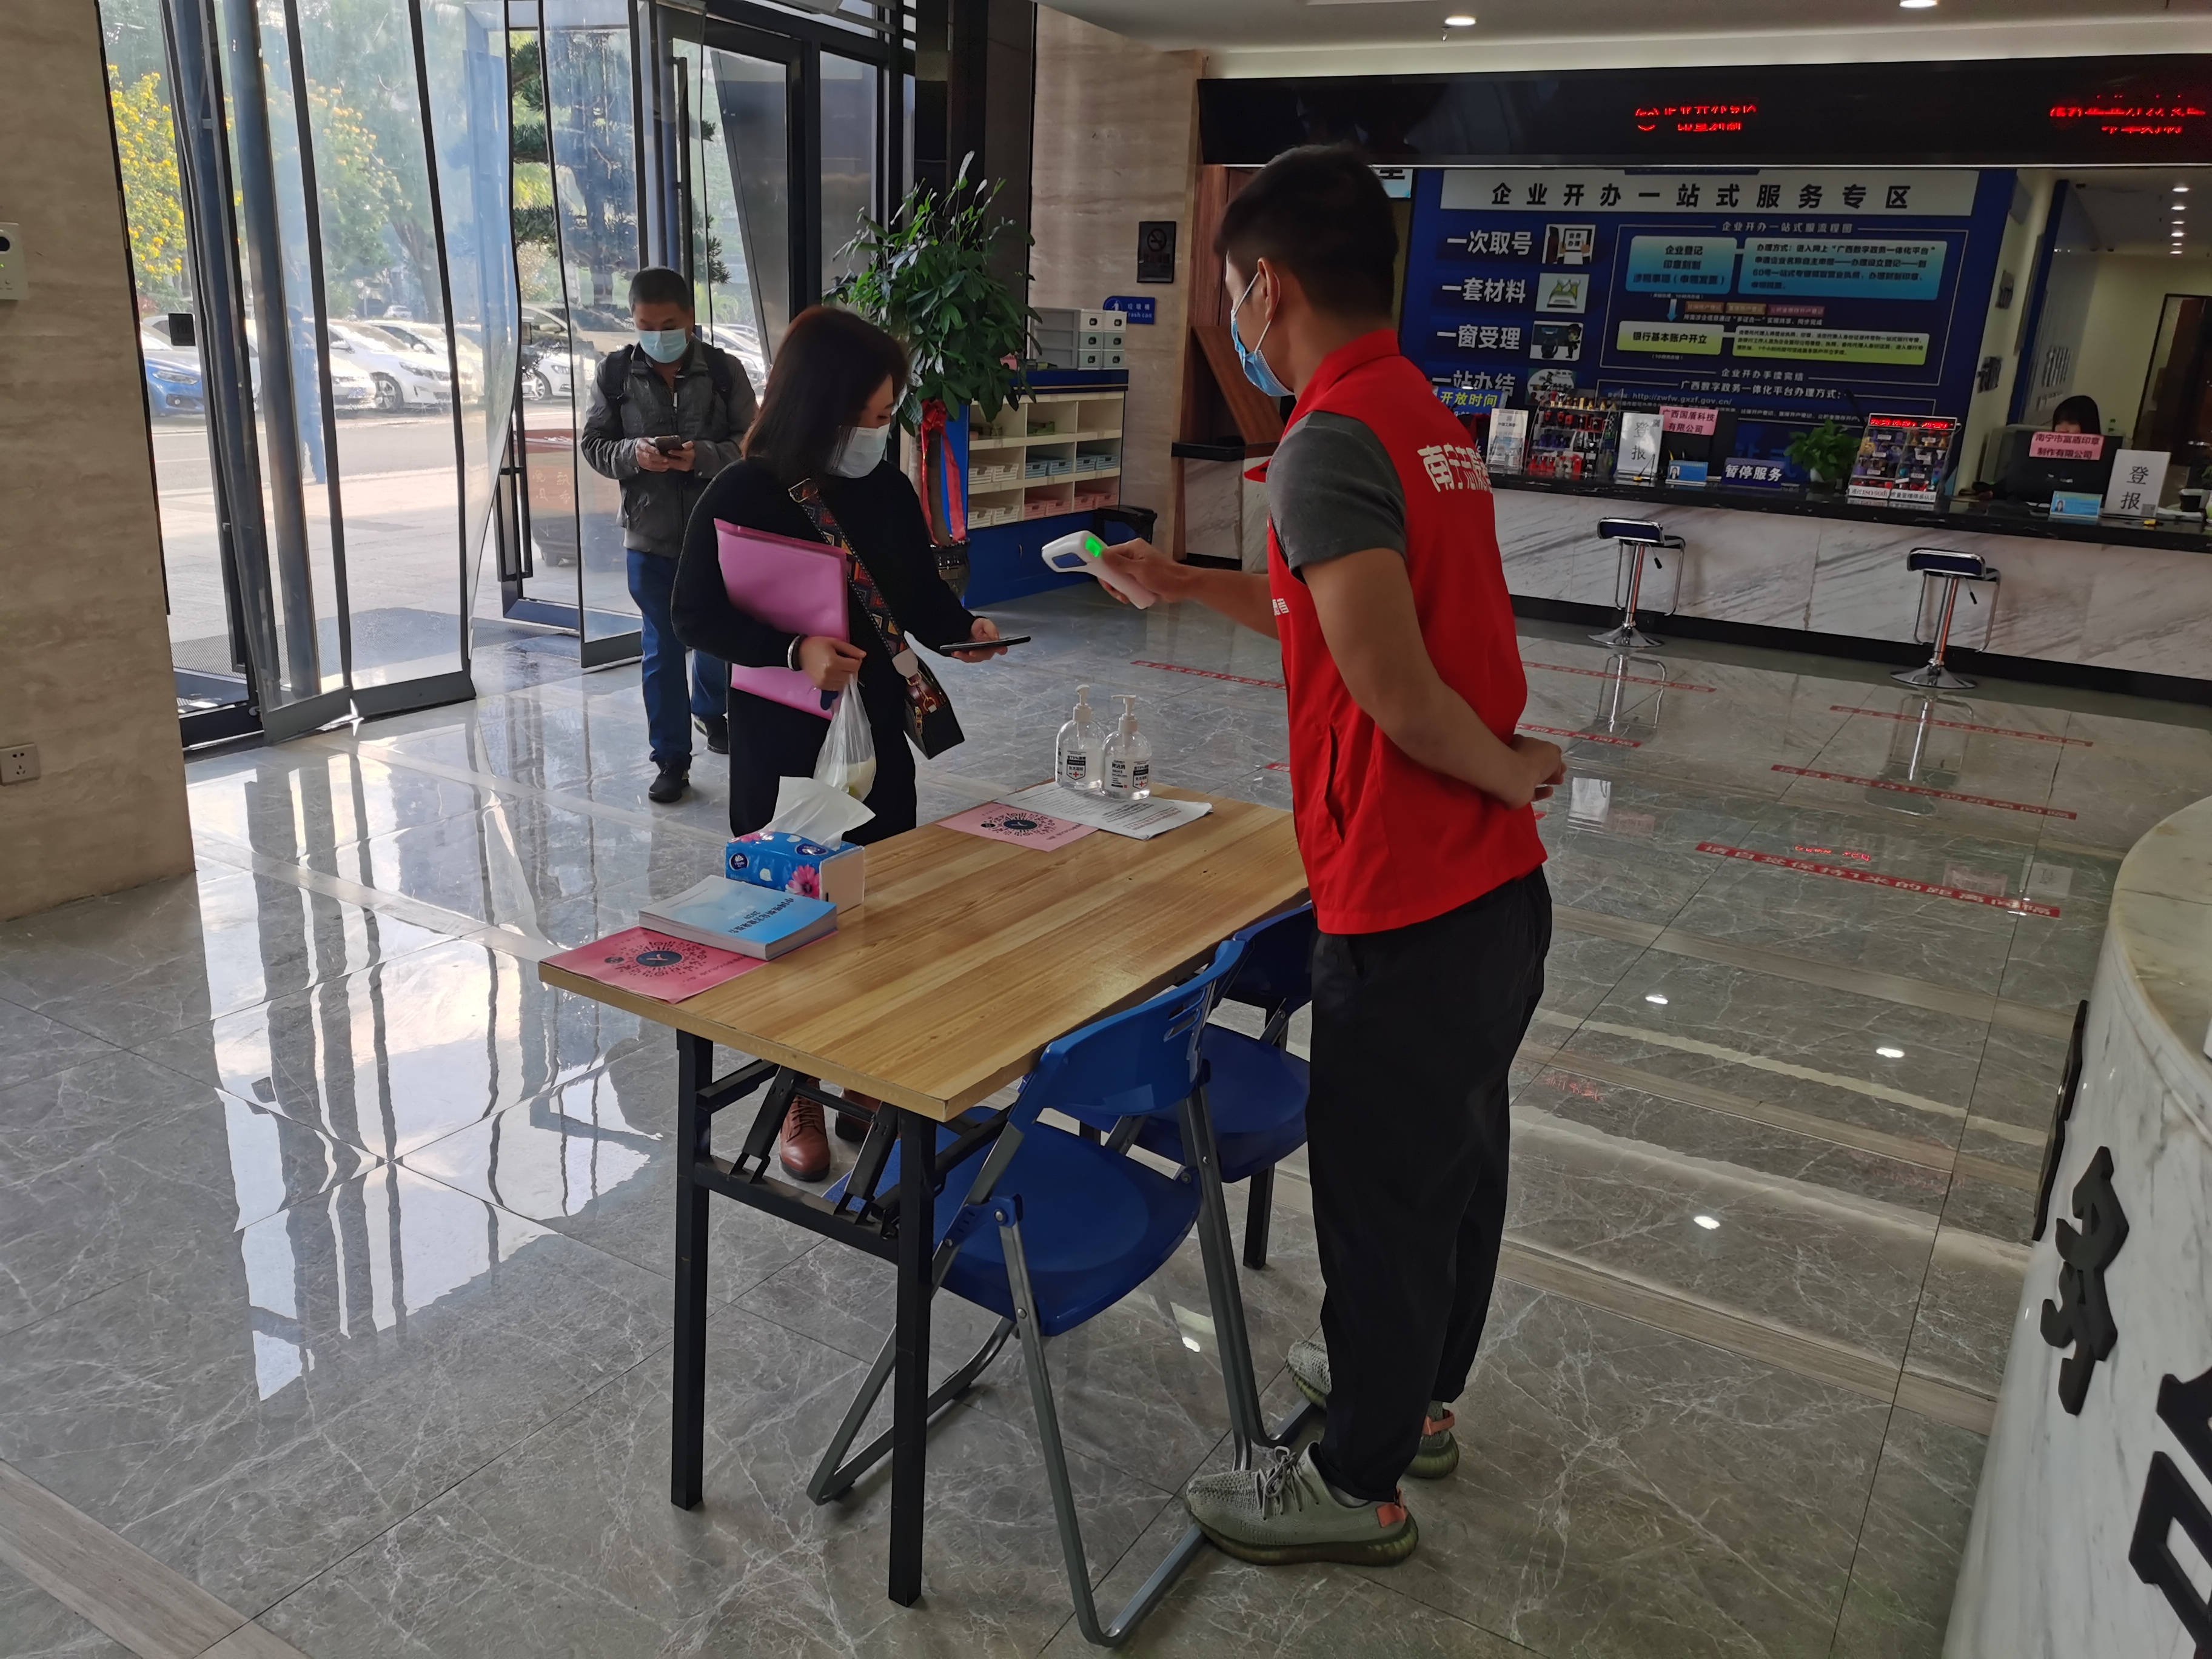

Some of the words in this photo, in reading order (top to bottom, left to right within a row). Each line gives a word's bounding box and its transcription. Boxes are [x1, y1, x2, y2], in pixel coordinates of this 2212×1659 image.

[1491, 183, 1911, 209] 企业开办一站式服务专区
[1447, 230, 1532, 255] 一次取号
[1664, 245, 1703, 256] 企业登记
[1441, 277, 1527, 304] 一套材料
[1436, 324, 1521, 350] 一窗受理
[1632, 331, 1708, 345] 银行基本账户开立
[1432, 369, 1516, 397] 一站办结
[1439, 390, 1498, 408] 开放时间
[1663, 408, 1715, 423] 广西国盾科技
[1667, 423, 1703, 434] 有限公司
[2036, 446, 2093, 461] 制作有限公司
[1724, 463, 1785, 483] 暂停服务
[2119, 465, 2150, 511] 登报
